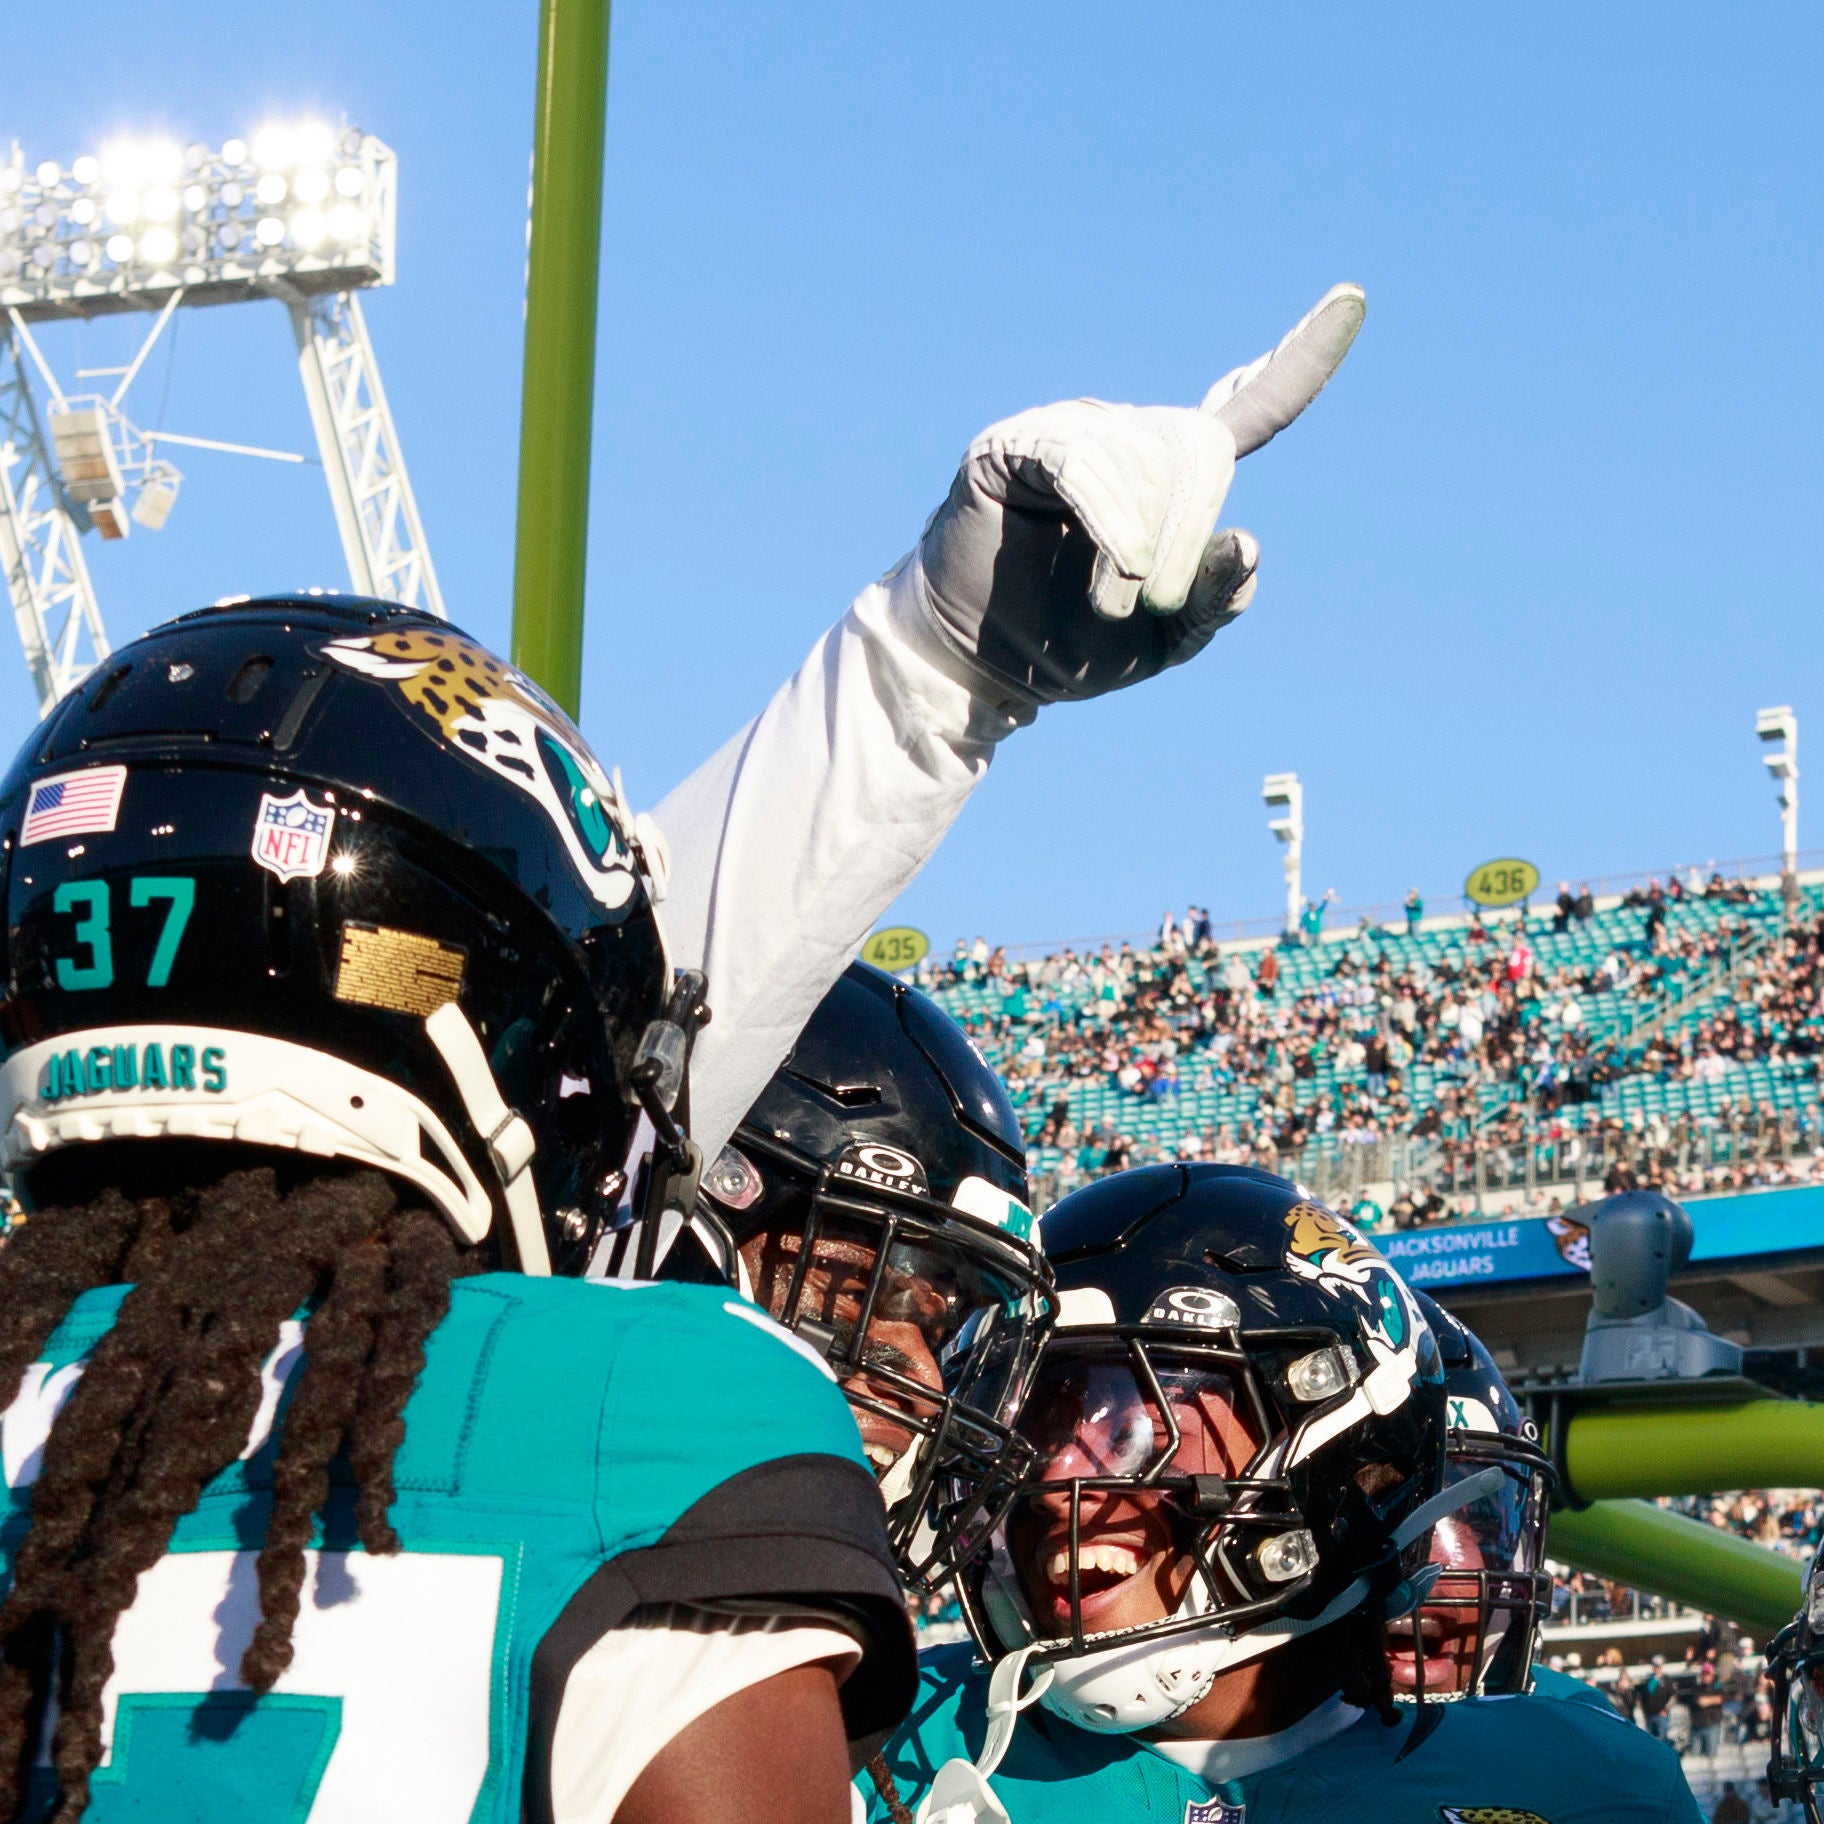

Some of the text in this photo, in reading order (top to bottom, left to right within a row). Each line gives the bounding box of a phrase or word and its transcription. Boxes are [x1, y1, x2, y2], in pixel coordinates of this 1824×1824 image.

[1477, 867, 1523, 895] 436
[53, 876, 195, 992] 37
[871, 936, 914, 960] 435
[39, 1043, 226, 1101] JAGUARS
[1386, 1227, 1519, 1259] JACKSONVILLE
[1409, 1256, 1494, 1282] JAGUARS
